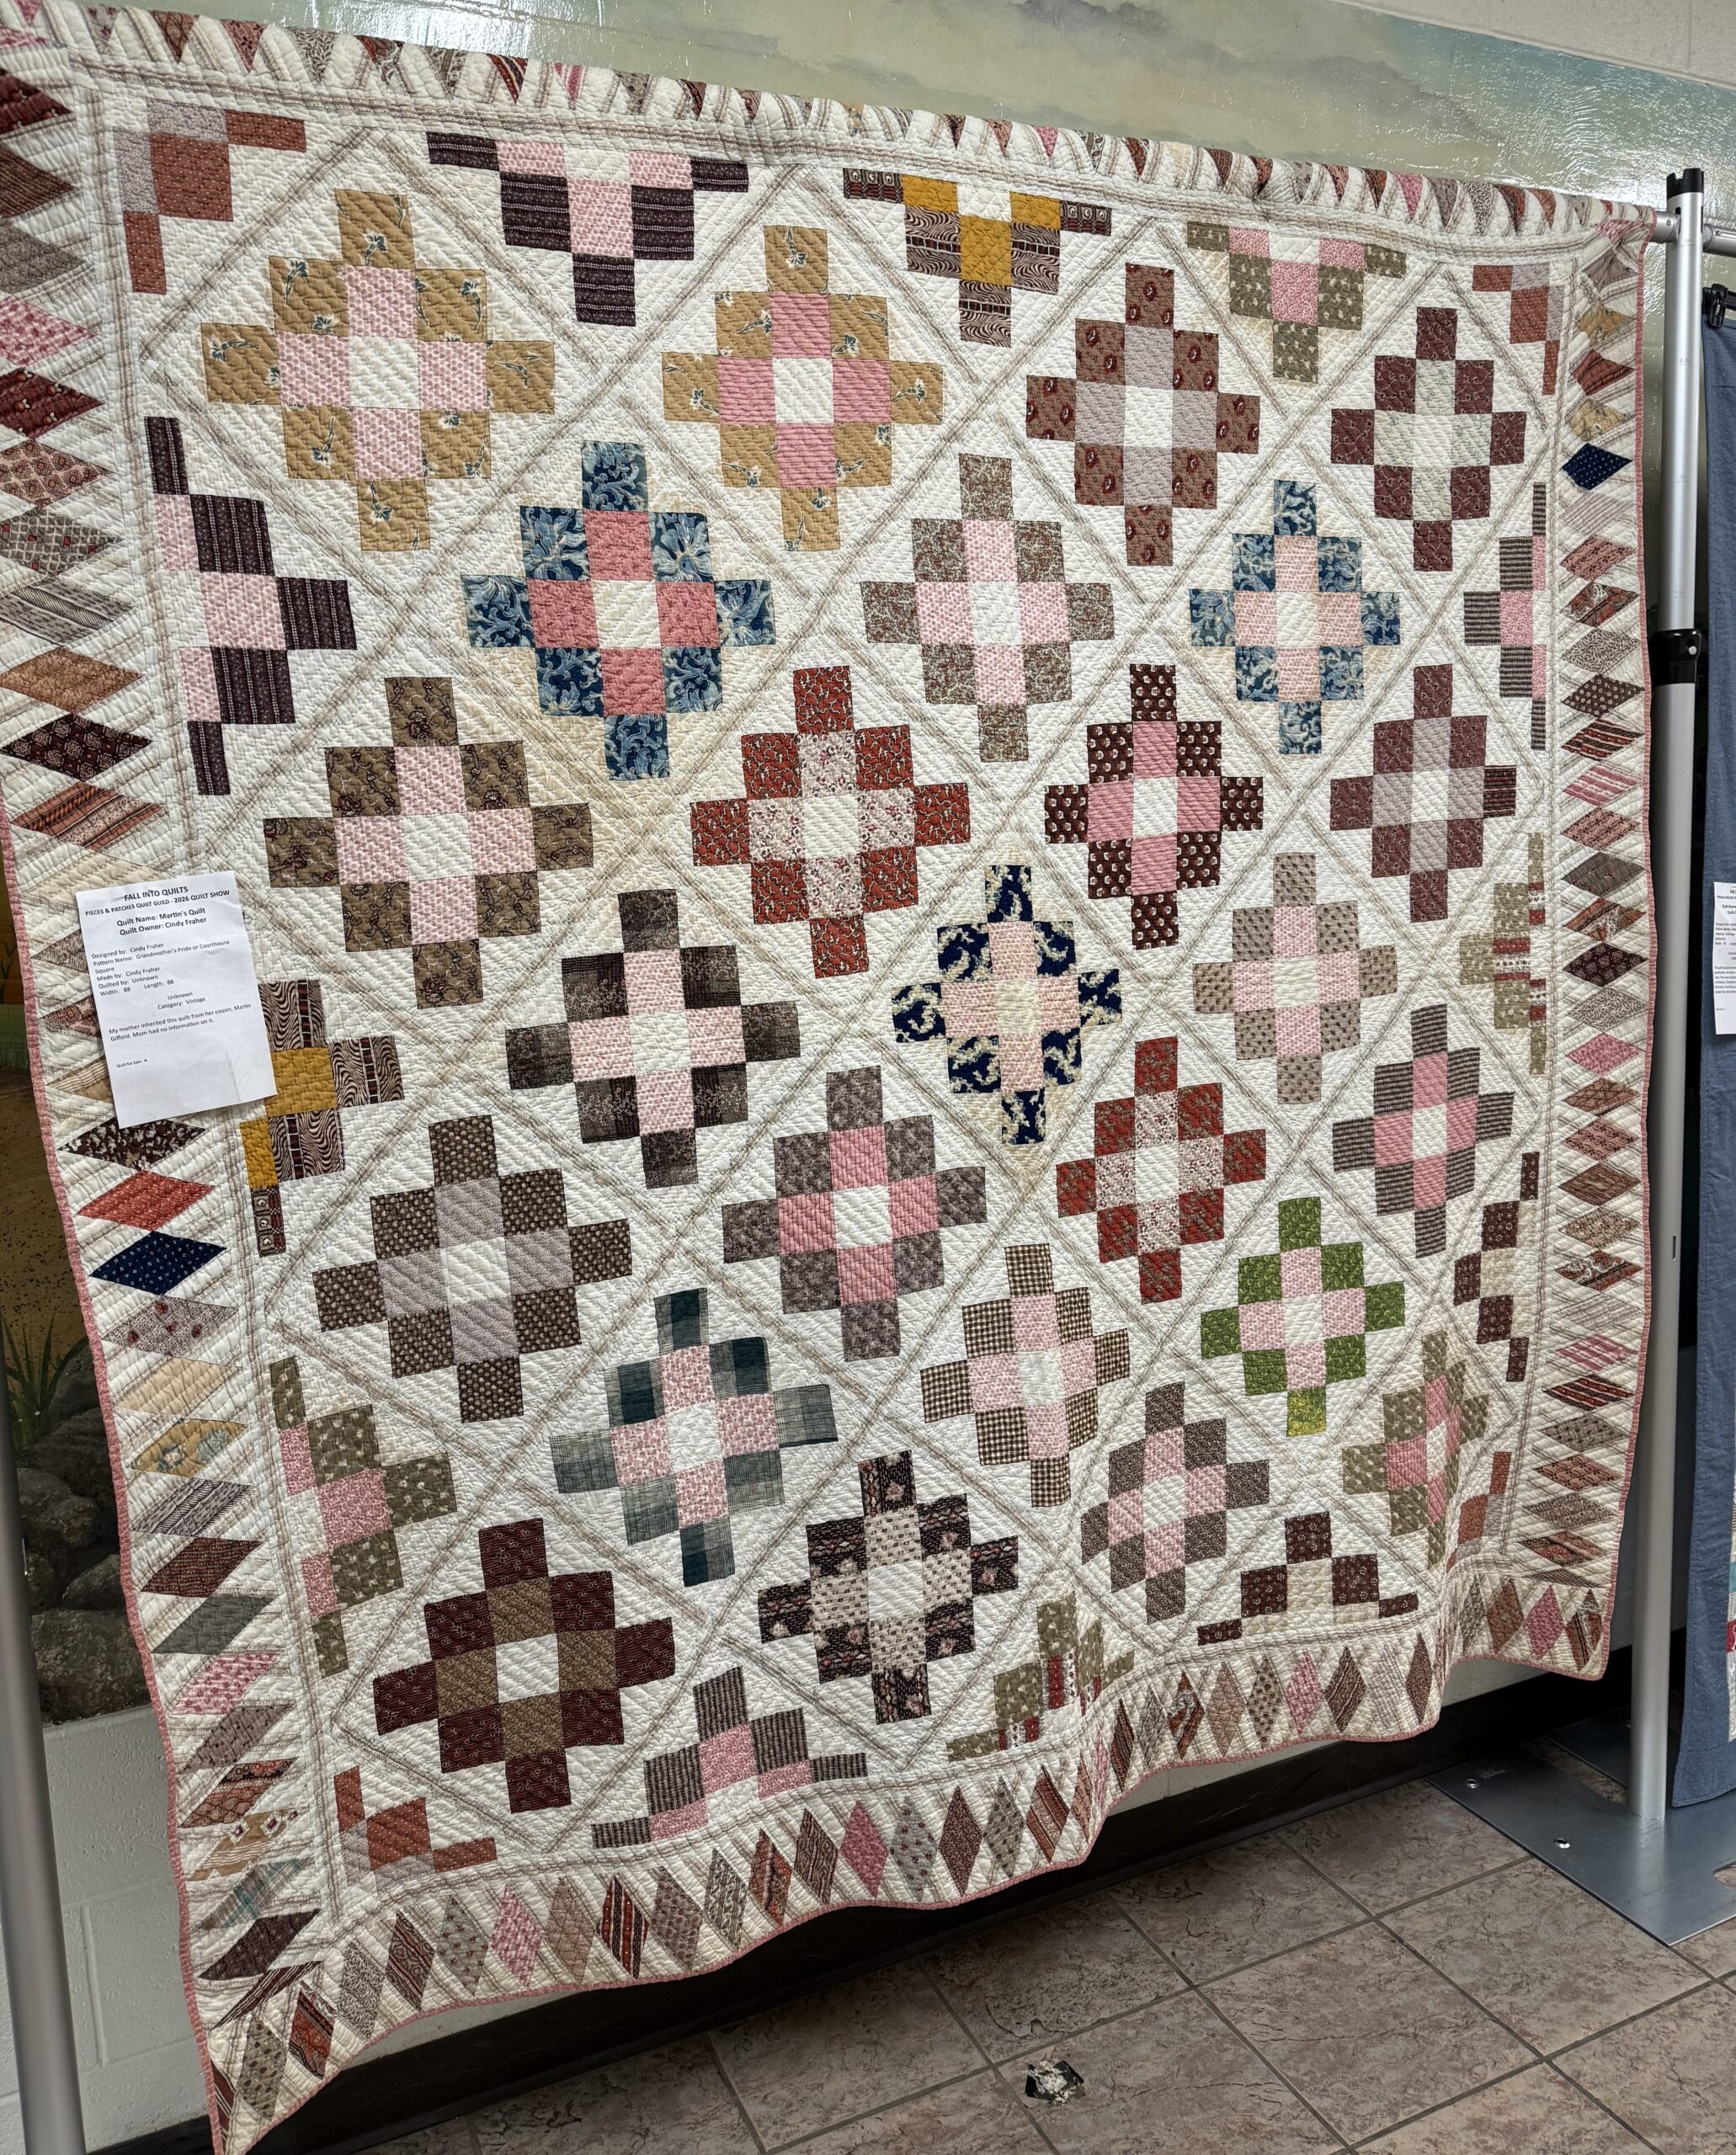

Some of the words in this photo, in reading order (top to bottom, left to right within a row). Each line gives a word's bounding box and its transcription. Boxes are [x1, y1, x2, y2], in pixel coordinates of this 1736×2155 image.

[124, 893, 141, 901] FALL
[162, 886, 188, 896] QUILTS
[111, 904, 135, 913] PATCHES
[116, 918, 135, 926] Quilt
[159, 910, 187, 920] Martin's
[120, 927, 138, 936] Quilt
